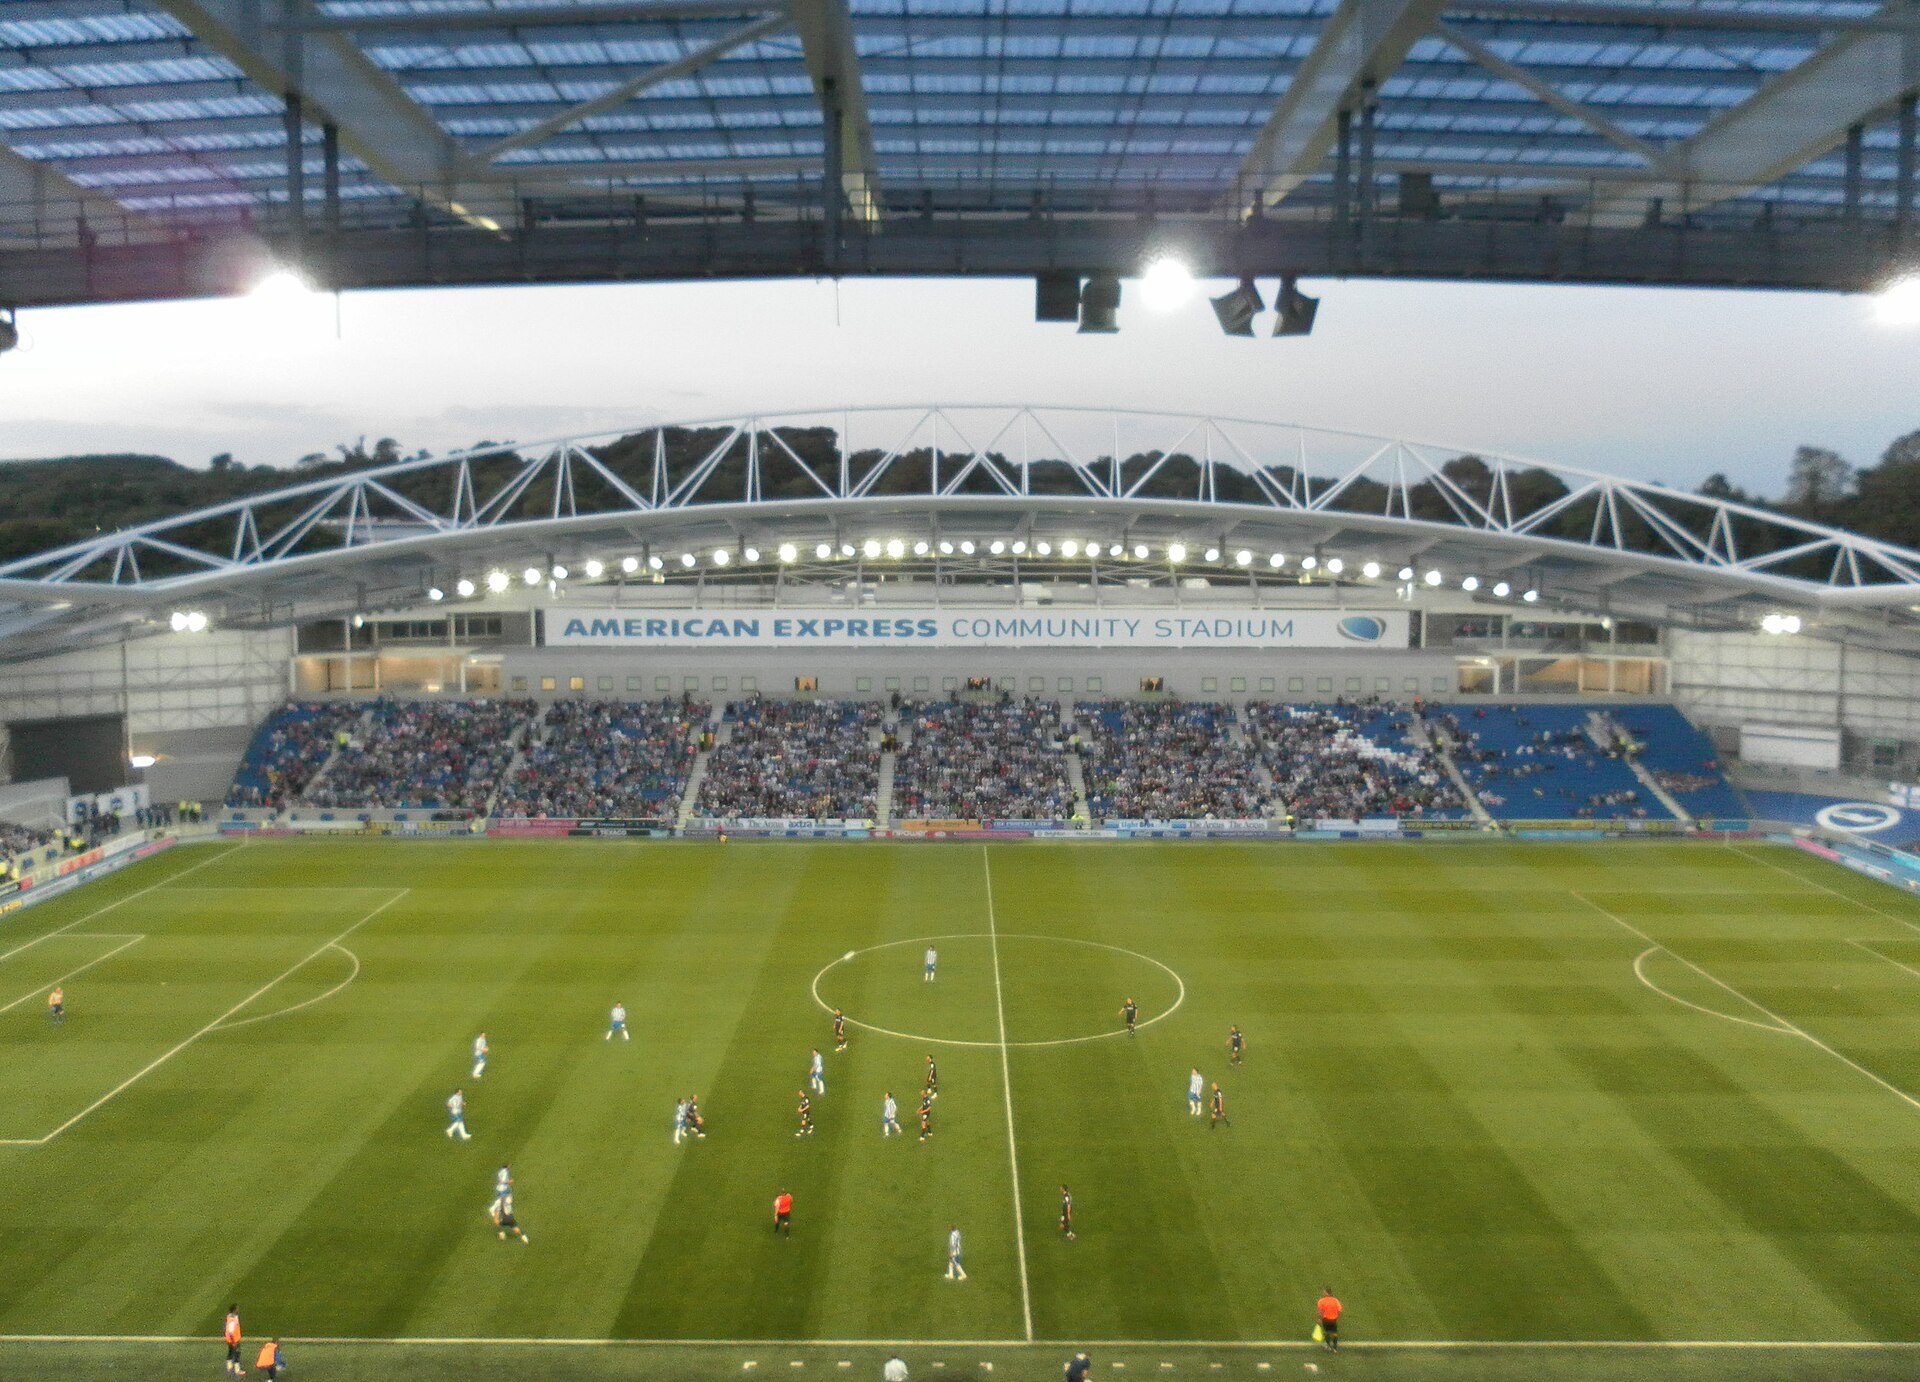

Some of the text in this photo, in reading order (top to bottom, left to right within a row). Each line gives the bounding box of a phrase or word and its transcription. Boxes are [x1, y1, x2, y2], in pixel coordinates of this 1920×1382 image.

[563, 618, 1294, 638] AMERICAN EXPRESS COMMUNITY STADIUM
